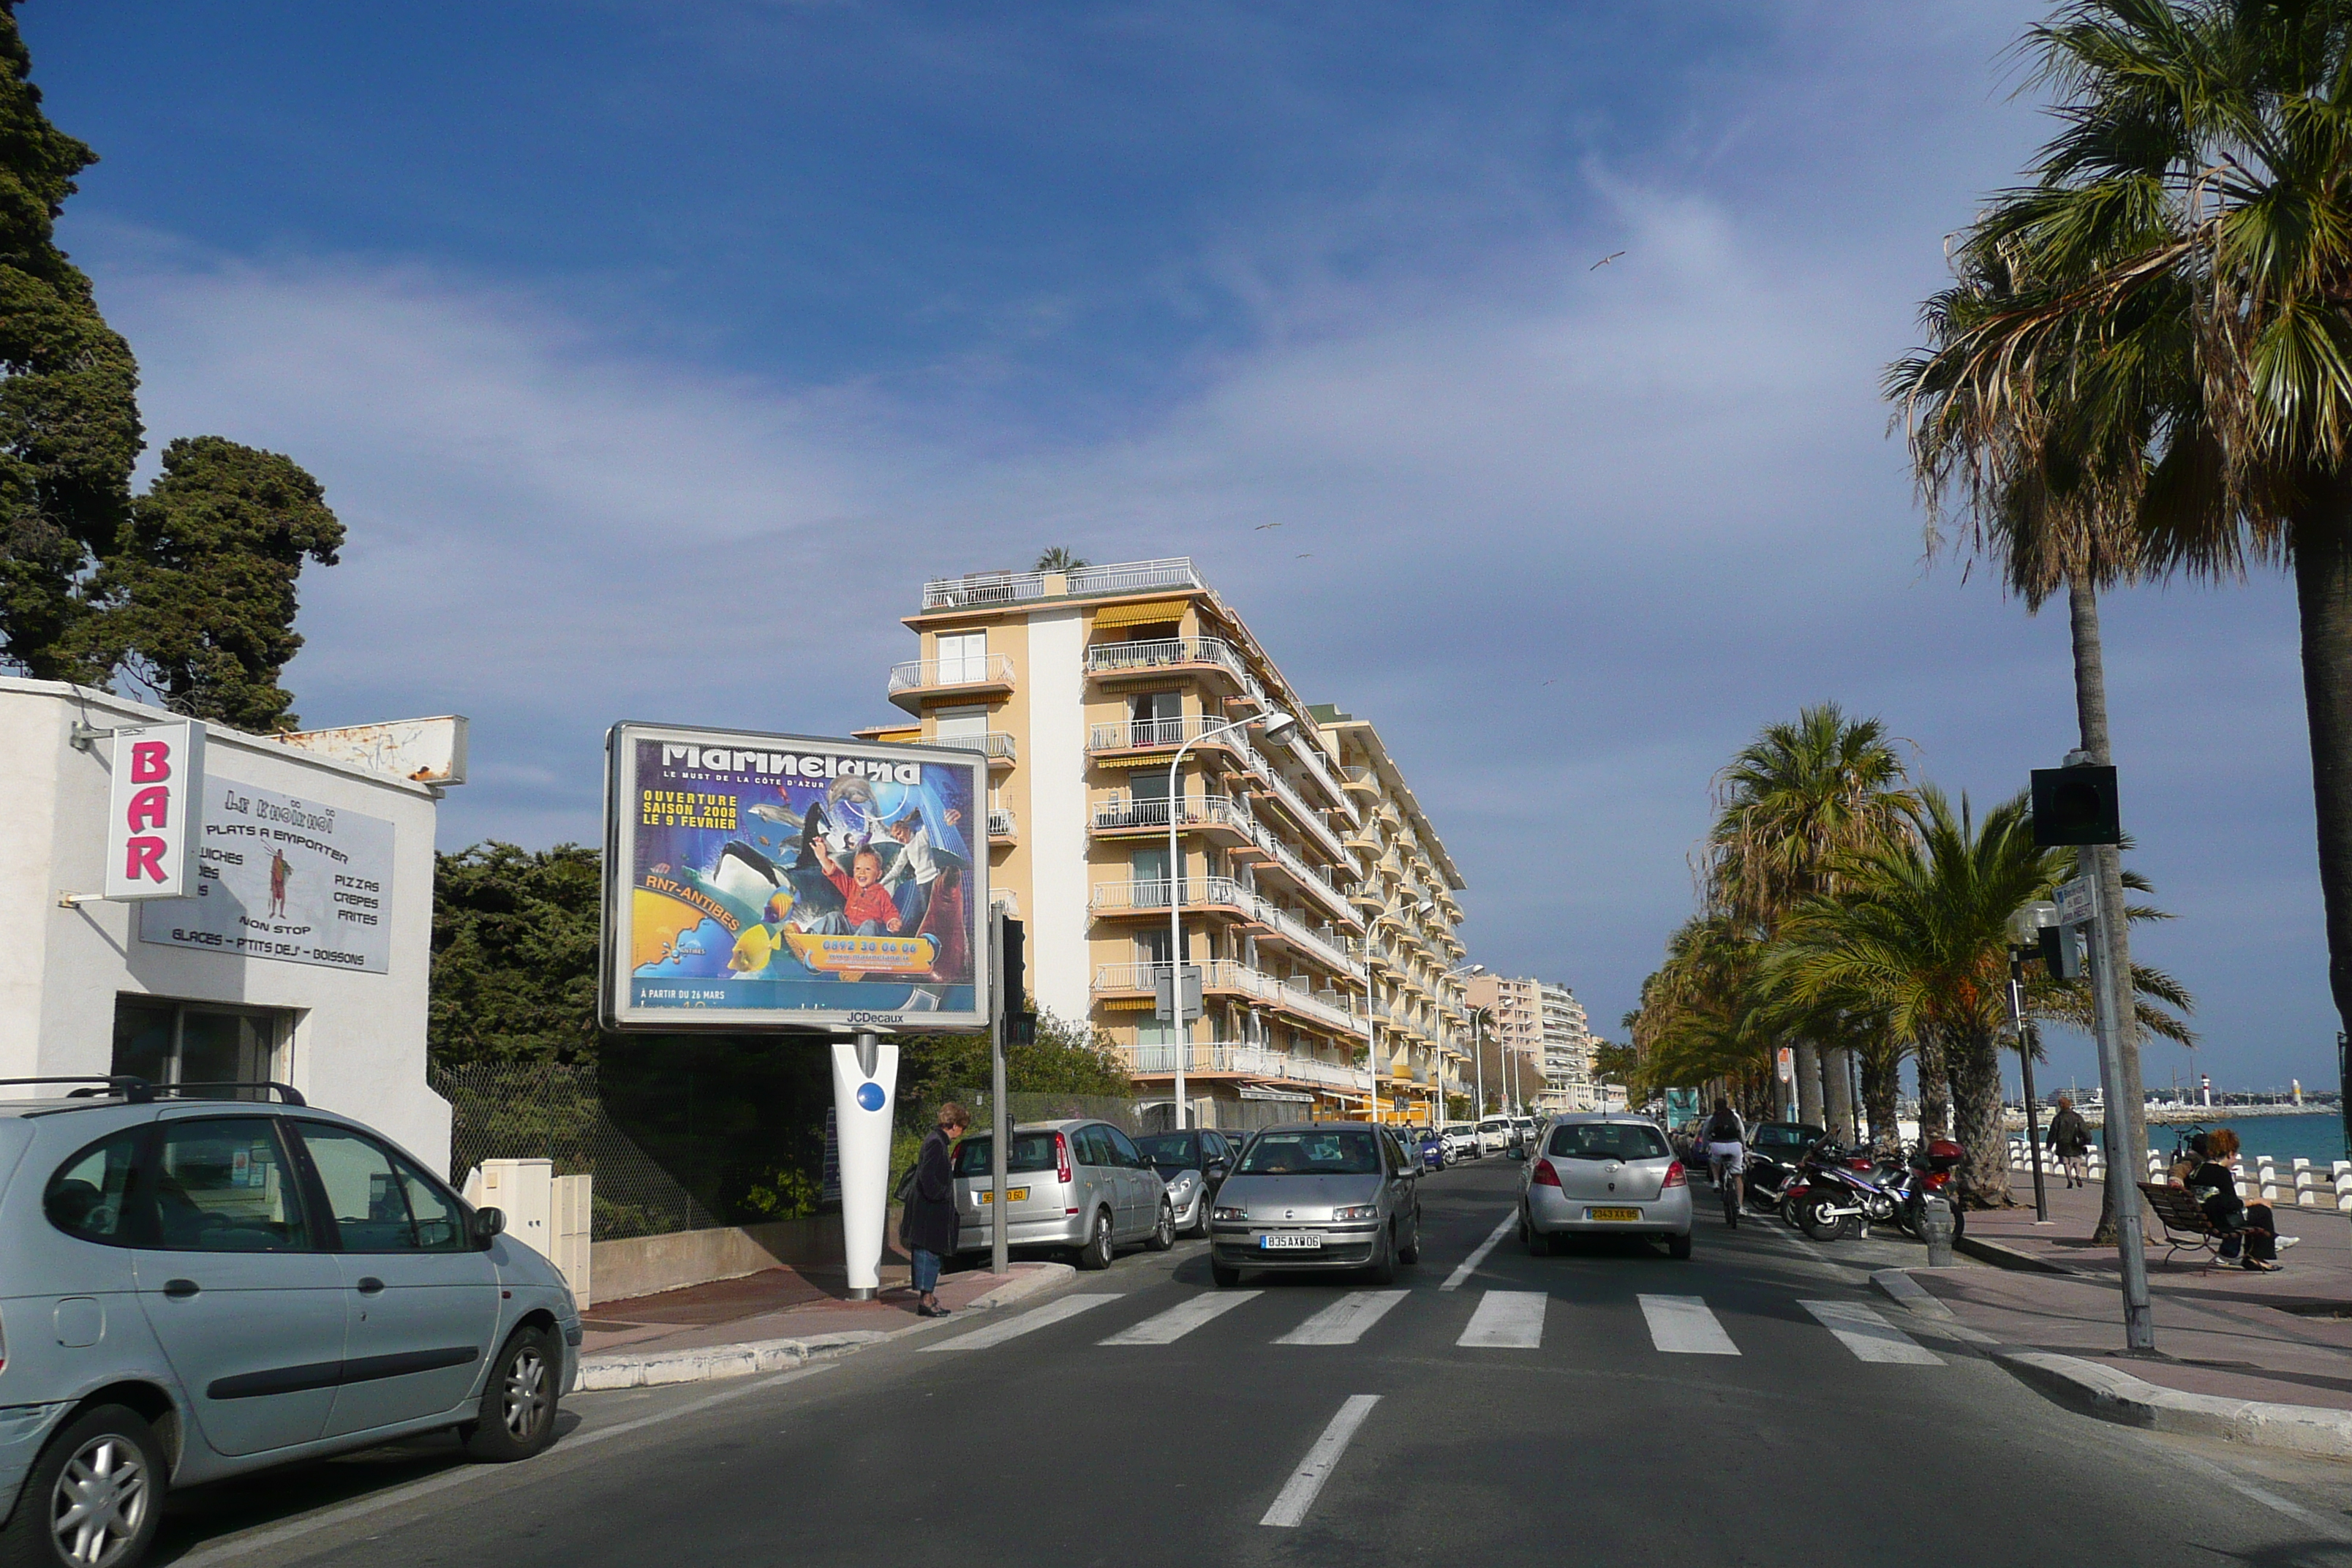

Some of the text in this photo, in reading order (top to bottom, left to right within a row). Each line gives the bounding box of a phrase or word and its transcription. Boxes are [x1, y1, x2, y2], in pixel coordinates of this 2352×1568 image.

[682, 772, 710, 780] MUST
[755, 776, 781, 785] CÔTE
[787, 780, 825, 788] D'AZUR
[644, 790, 737, 806] OUVERTURE
[127, 741, 170, 883] BAR
[644, 802, 736, 818] SAISON 2008
[643, 814, 736, 829] LE 9 FEVRIER
[206, 825, 349, 864] PLATS A EMPORTER
[335, 874, 379, 892] PIZZAS
[333, 892, 378, 909] CREPES
[646, 875, 740, 931] RN7-ANTIBES
[239, 916, 311, 935] NON STOP
[338, 910, 377, 925] FRITES
[173, 929, 222, 946] GLACES
[313, 949, 364, 965] BOISSONS
[823, 941, 917, 952] 0892 30 06 06
[641, 987, 725, 999] À PARTIR DU 26 MARS
[847, 1012, 903, 1023] JCDecaux
